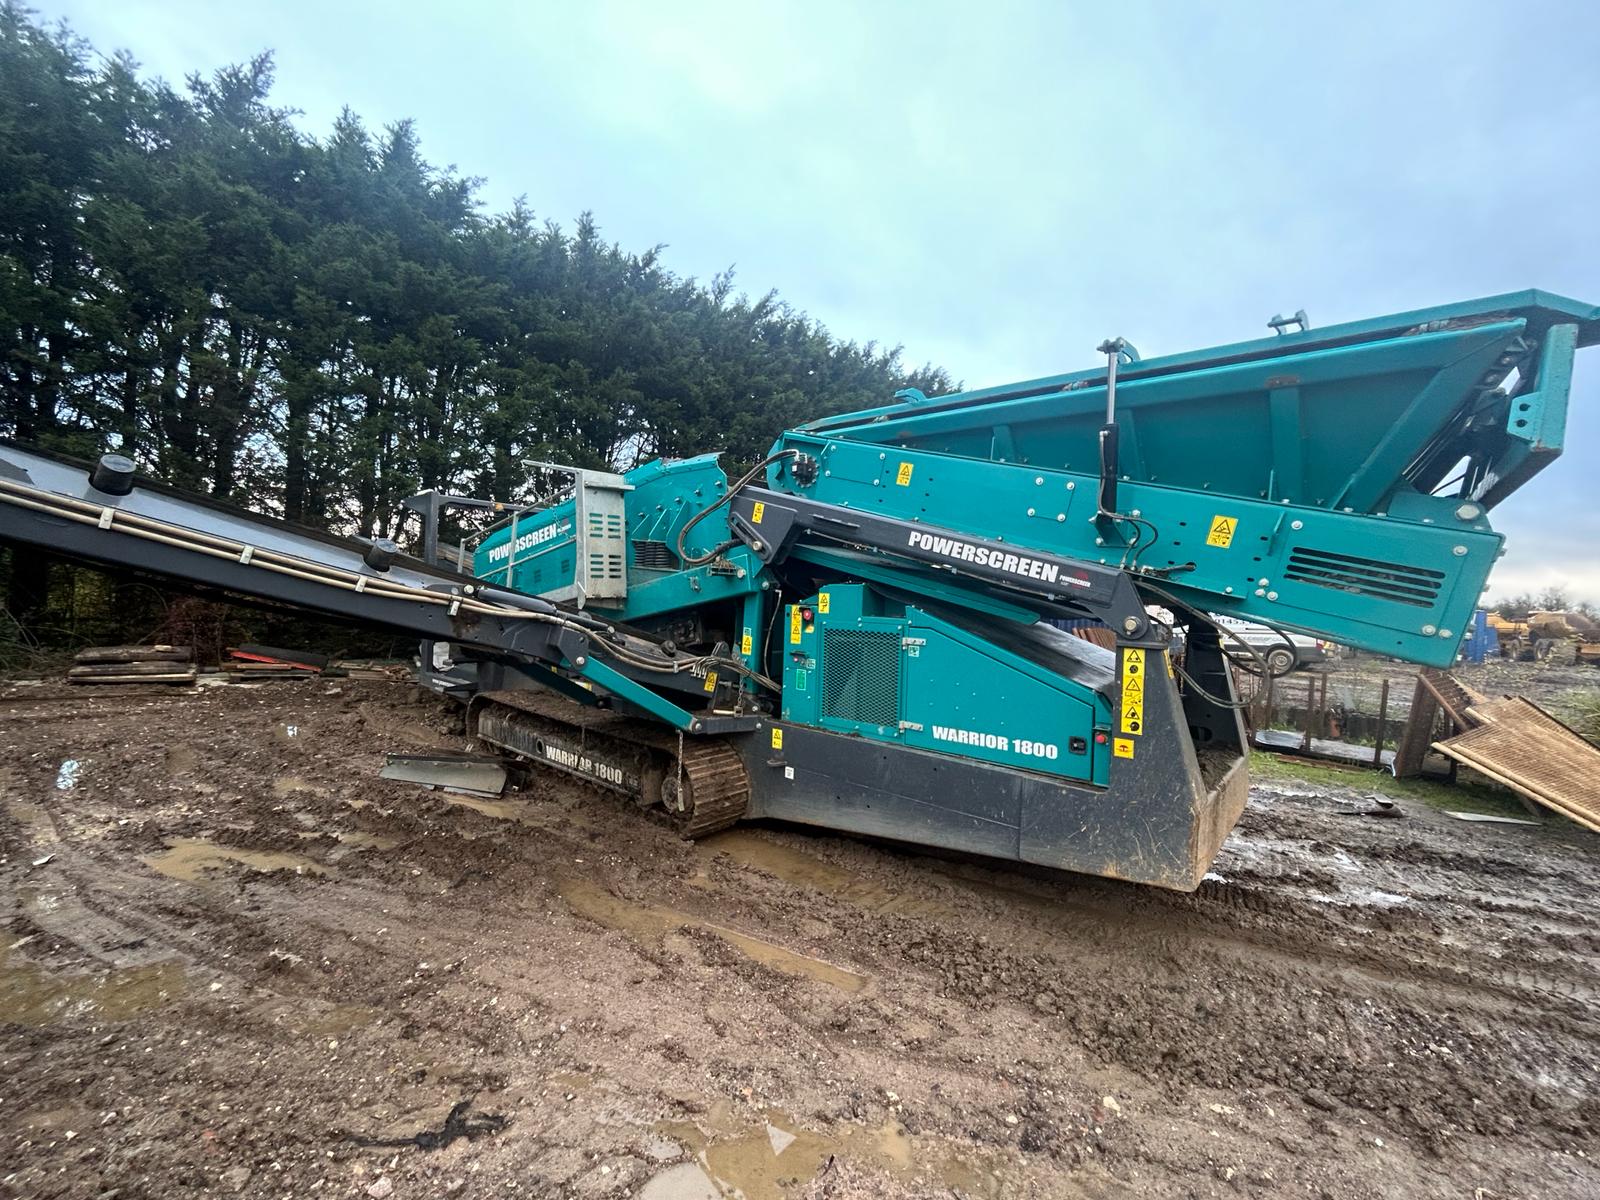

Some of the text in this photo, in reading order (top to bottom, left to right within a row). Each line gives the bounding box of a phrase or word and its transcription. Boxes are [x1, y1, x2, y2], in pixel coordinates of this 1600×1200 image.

[489, 524, 557, 563] POWRSCREEN
[908, 531, 1059, 583] POWERSCREEN
[932, 725, 1058, 760] WARRIOR 1800
[594, 762, 622, 785] 1800
